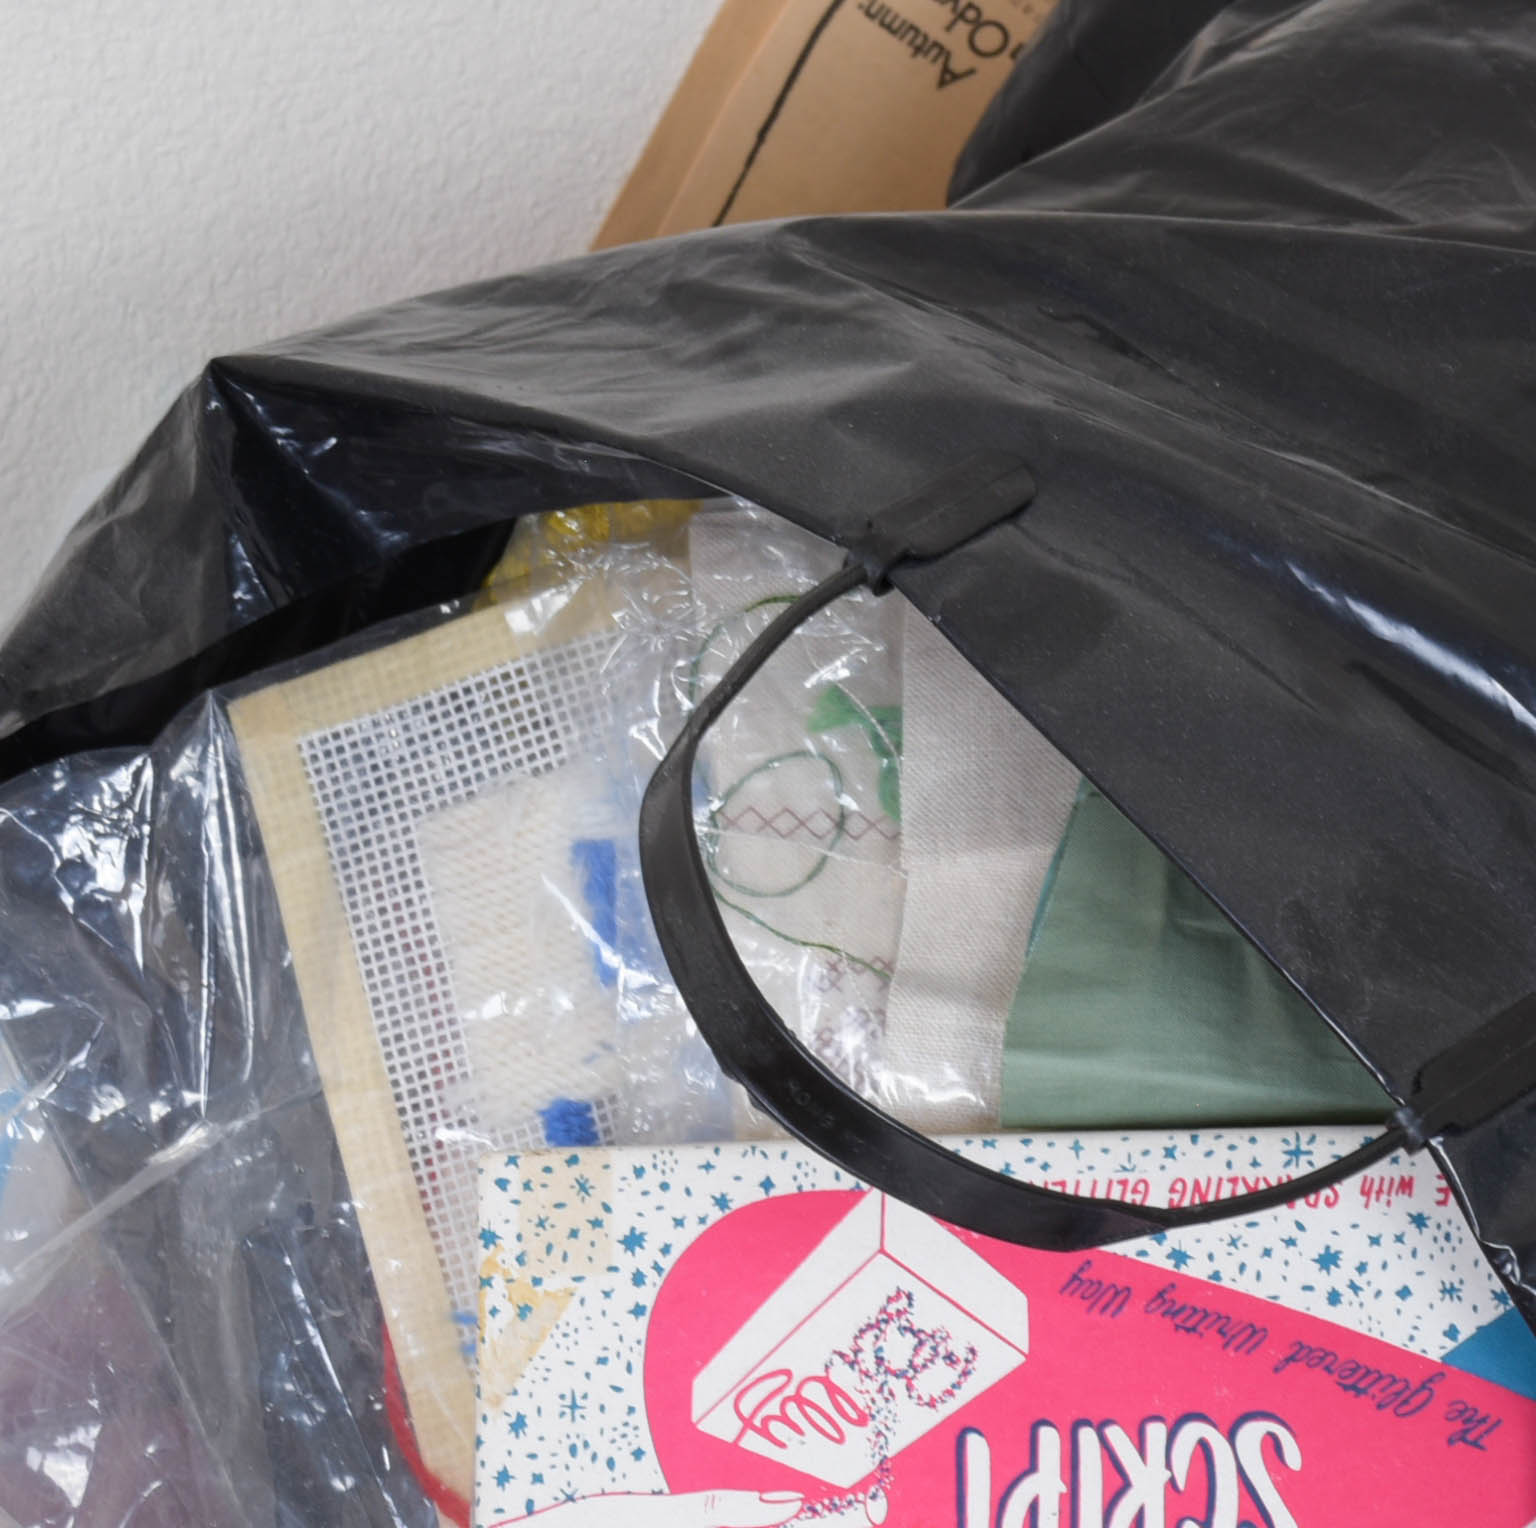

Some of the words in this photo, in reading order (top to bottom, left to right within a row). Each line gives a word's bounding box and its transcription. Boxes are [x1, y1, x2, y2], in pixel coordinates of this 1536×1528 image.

[1360, 1175, 1414, 1209] with
[1058, 1260, 1131, 1319] Way
[1144, 1282, 1269, 1356] Writing
[1273, 1339, 1447, 1419] Glittered
[1445, 1407, 1502, 1451] The
